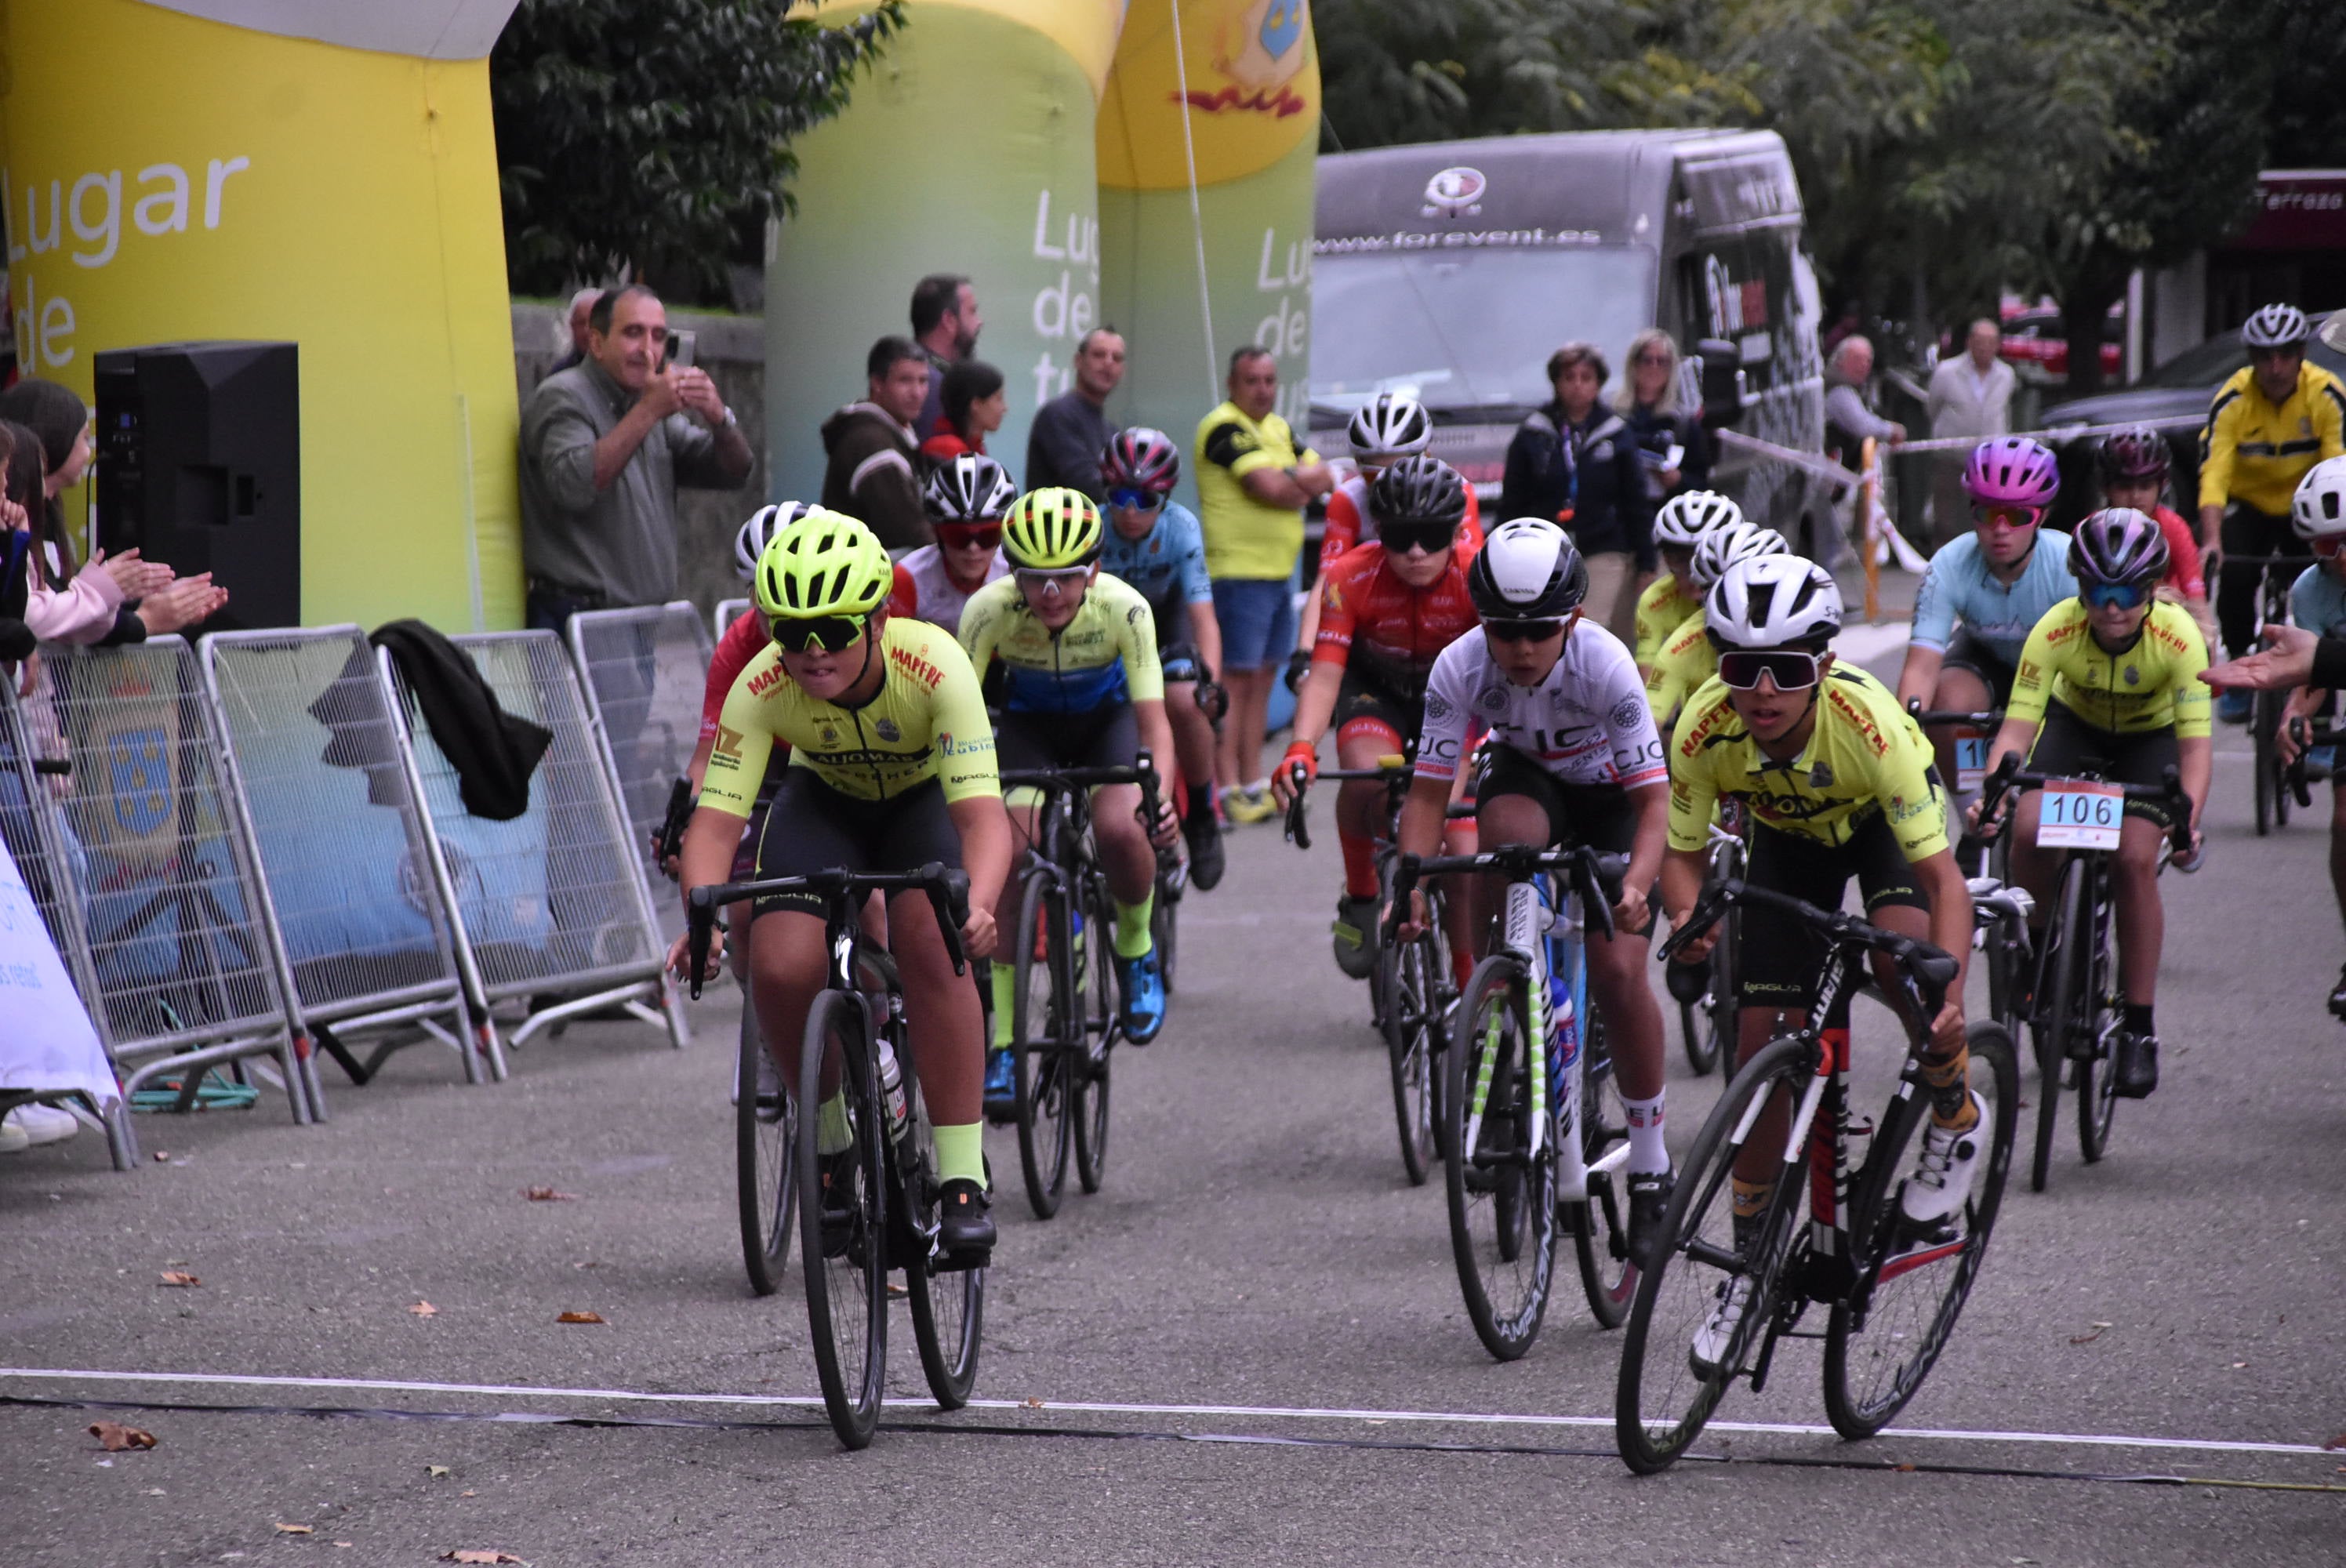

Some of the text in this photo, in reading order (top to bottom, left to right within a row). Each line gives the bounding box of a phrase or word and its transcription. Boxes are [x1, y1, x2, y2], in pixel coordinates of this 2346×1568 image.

[3, 156, 249, 267] Lugar
[1314, 227, 1601, 253] www.forevent.es
[1258, 227, 1313, 296] Lu
[16, 276, 75, 375] de
[1033, 270, 1092, 339] de
[891, 645, 946, 691] MAPFRE
[701, 786, 743, 800] AGLIA
[2053, 793, 2112, 826] 106
